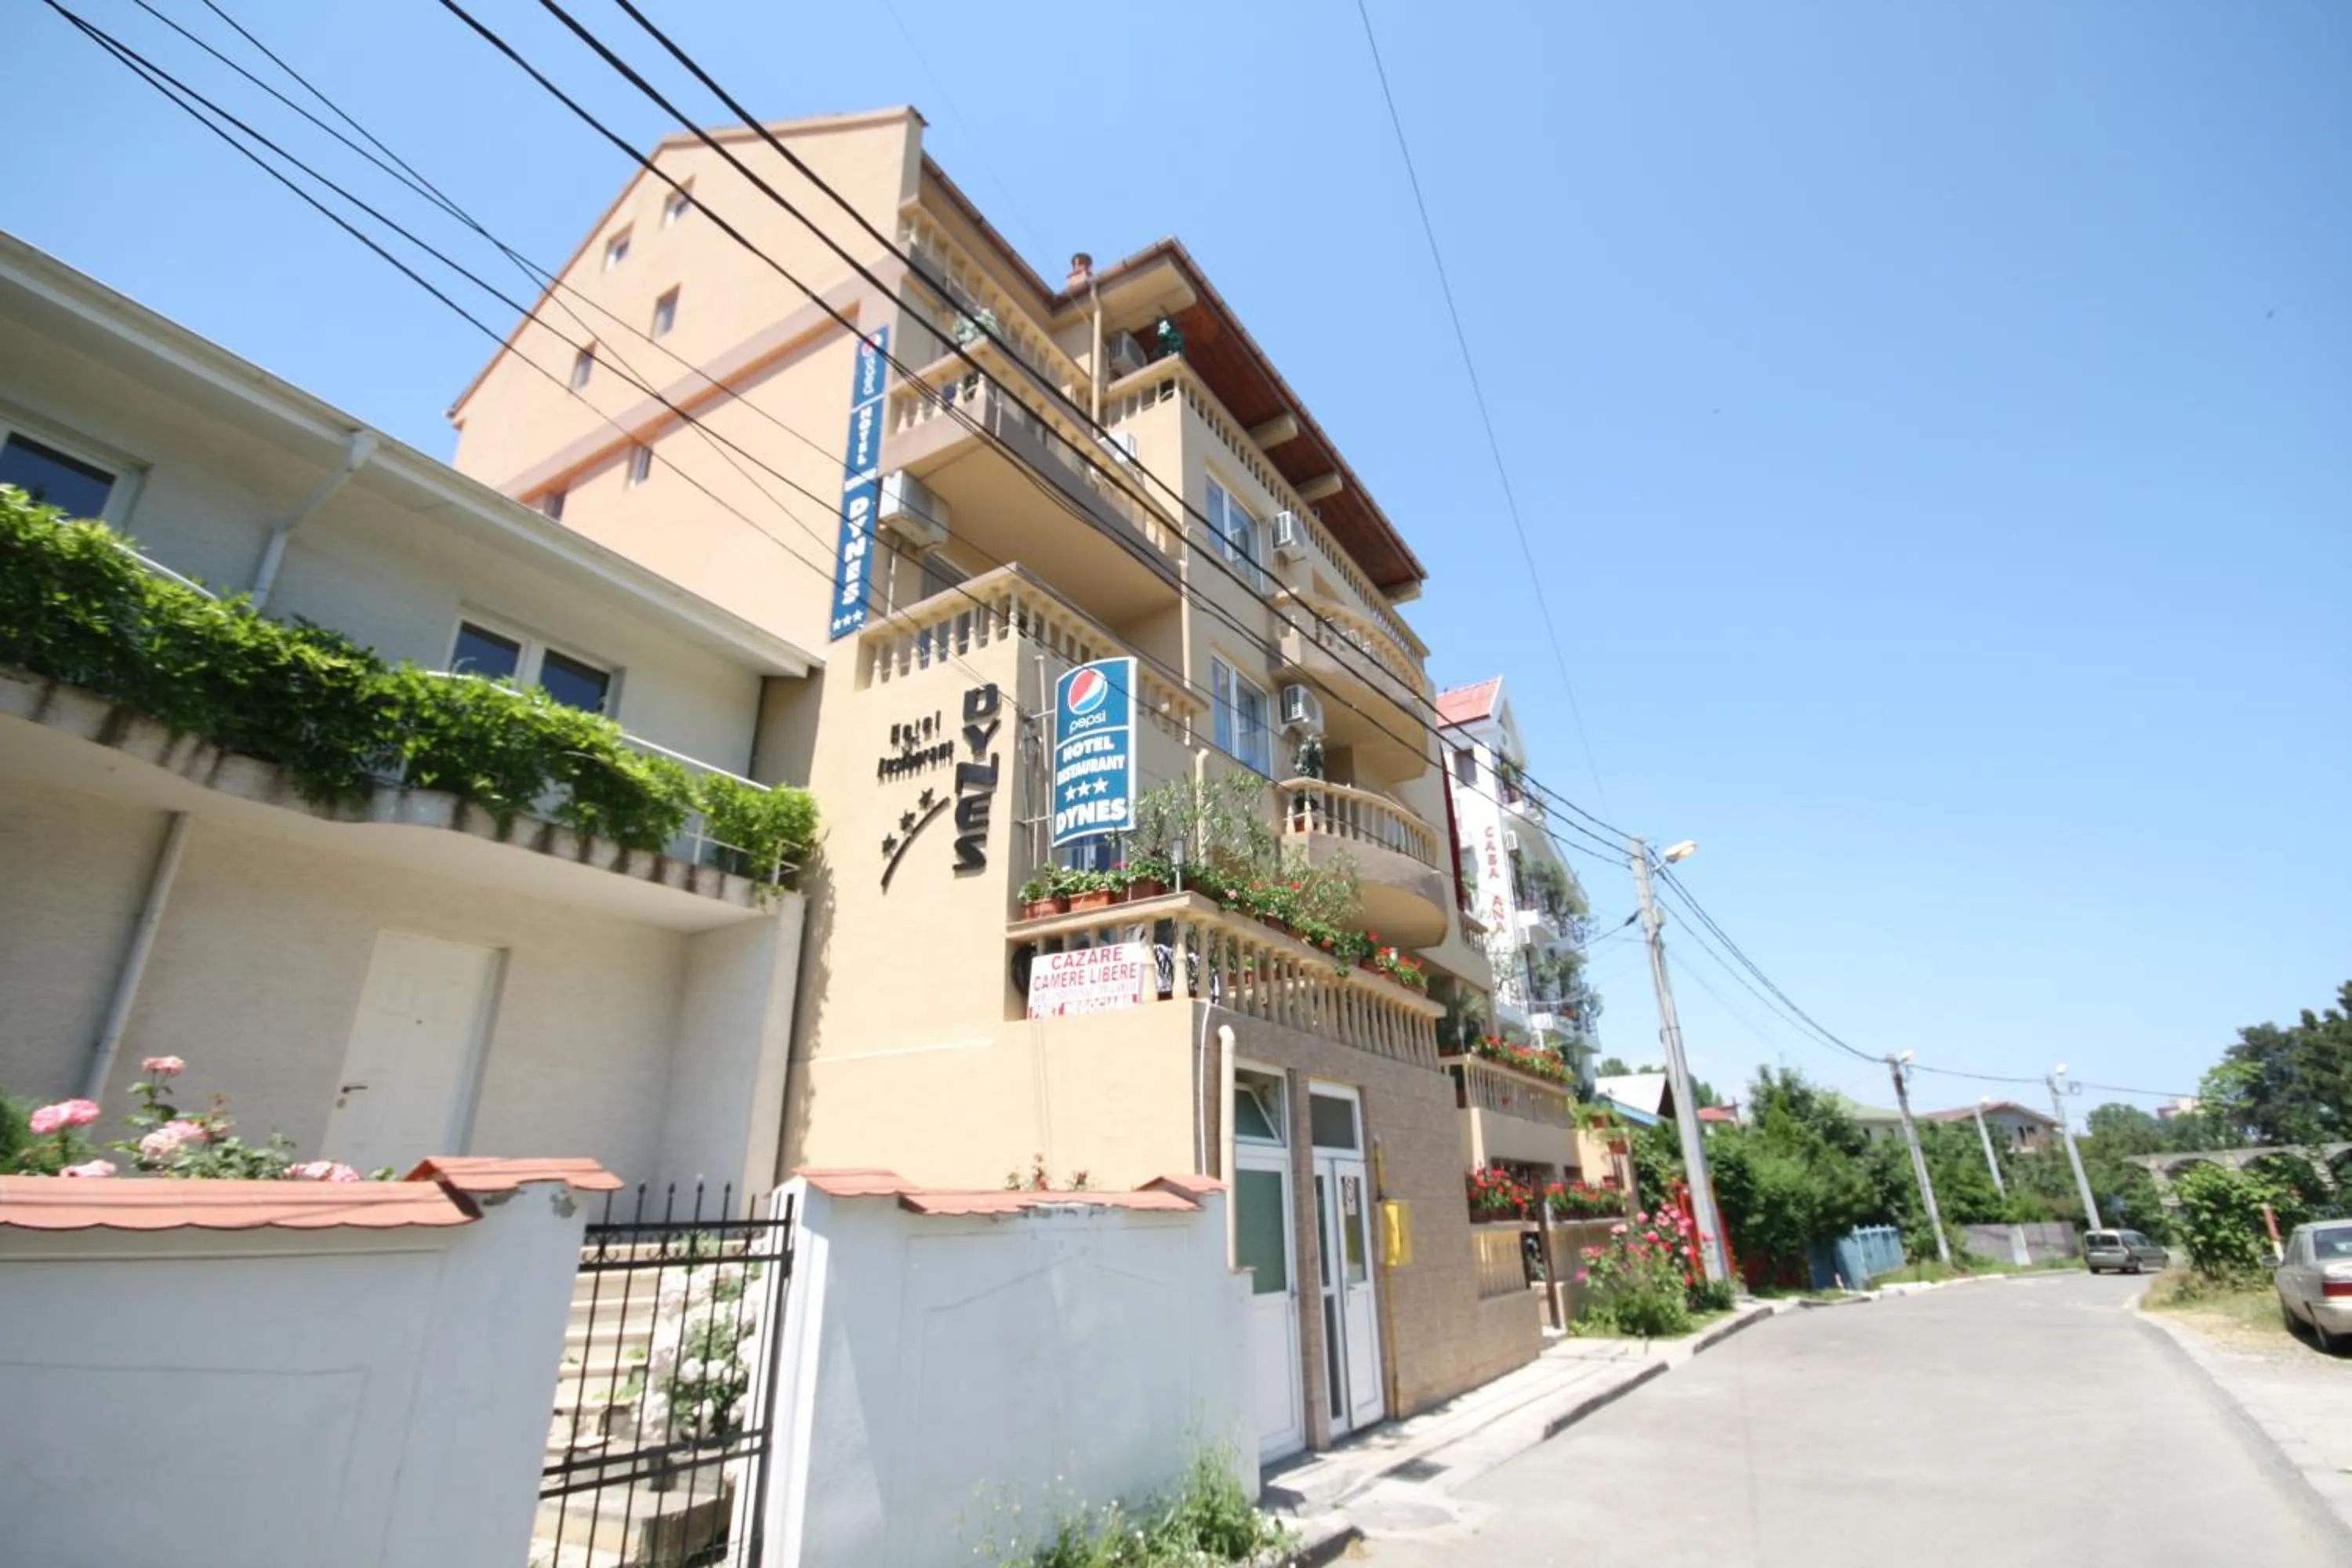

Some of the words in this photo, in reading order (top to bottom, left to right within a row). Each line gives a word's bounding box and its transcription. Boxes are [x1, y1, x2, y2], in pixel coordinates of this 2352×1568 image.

[842, 496, 869, 605] DYNES
[1069, 710, 1106, 735] pepsi
[1062, 735, 1115, 763] HOTEL
[952, 683, 1001, 877] DYNES
[1056, 754, 1125, 786] RESTAURANT
[1055, 797, 1127, 836] DYNES
[1051, 946, 1123, 971] CAZARE
[1033, 969, 1086, 992] CAMERE
[1090, 962, 1138, 984] LIBERE
